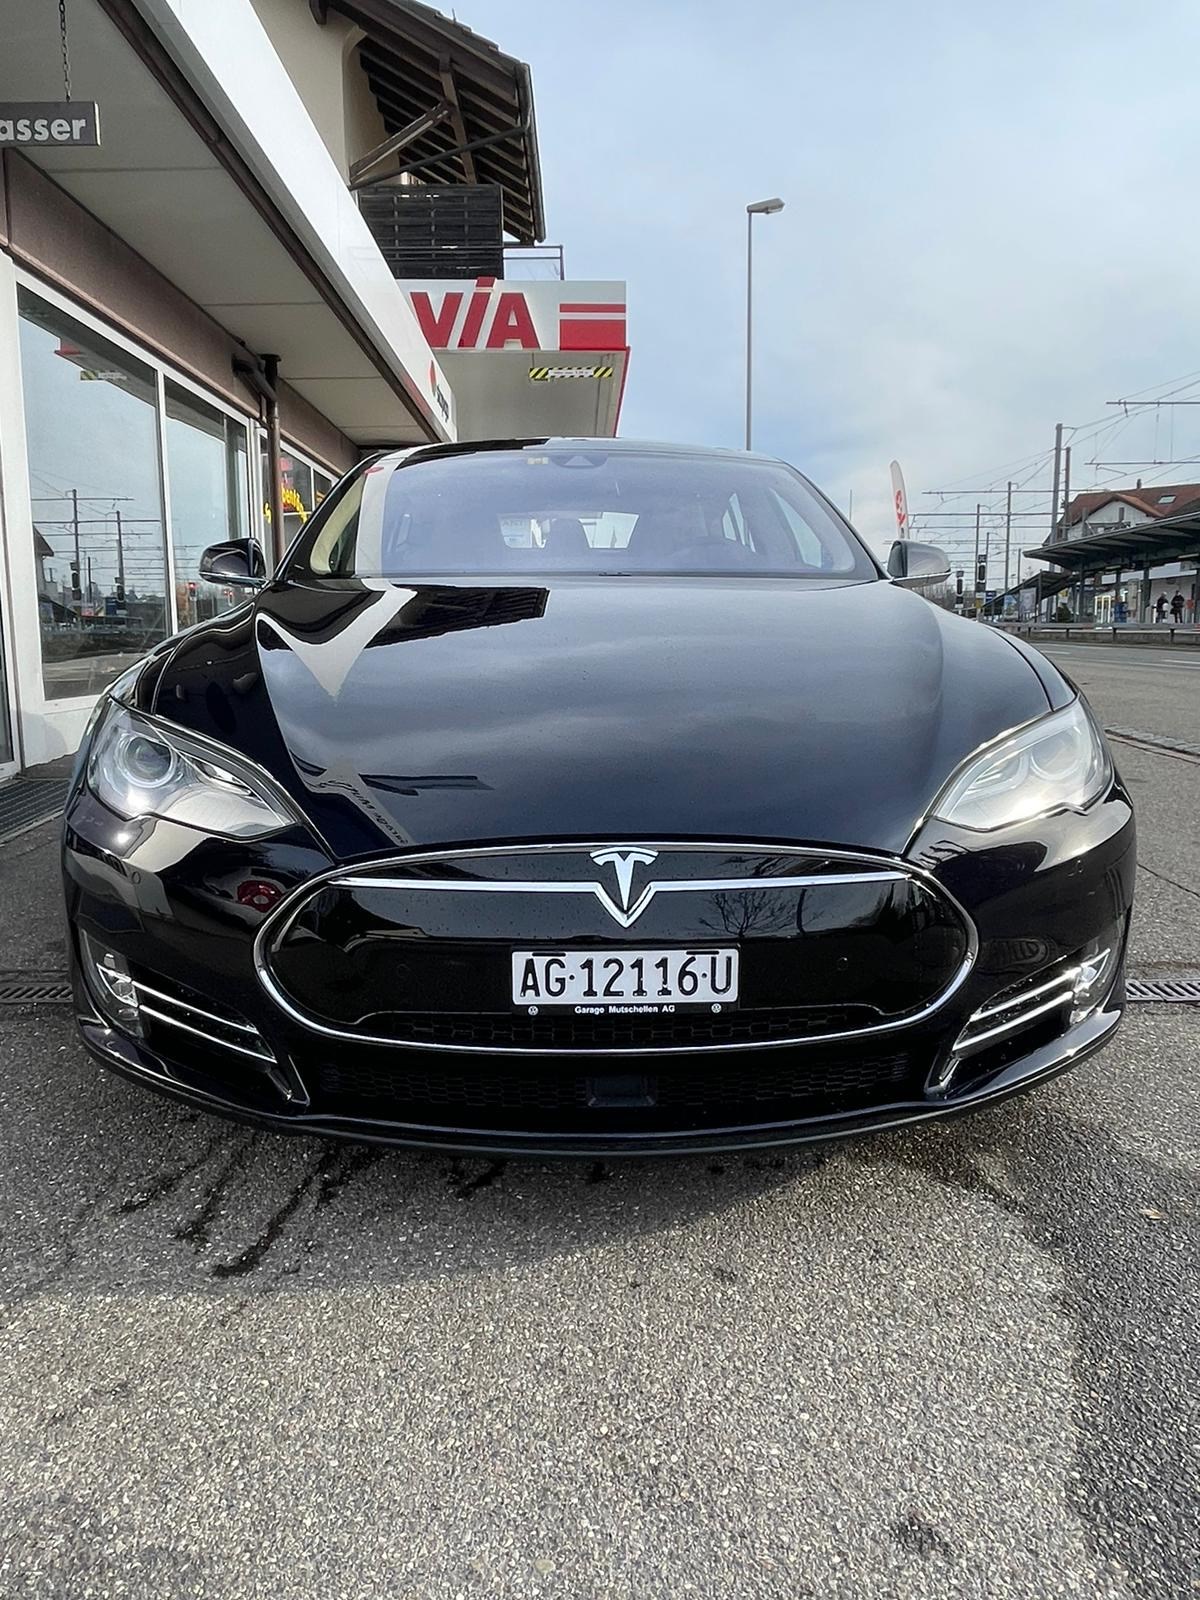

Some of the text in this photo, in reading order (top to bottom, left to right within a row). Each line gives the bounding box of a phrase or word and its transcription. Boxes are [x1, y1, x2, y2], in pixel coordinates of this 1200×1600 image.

[574, 1004, 676, 1015] Garage Mutschellen AG
